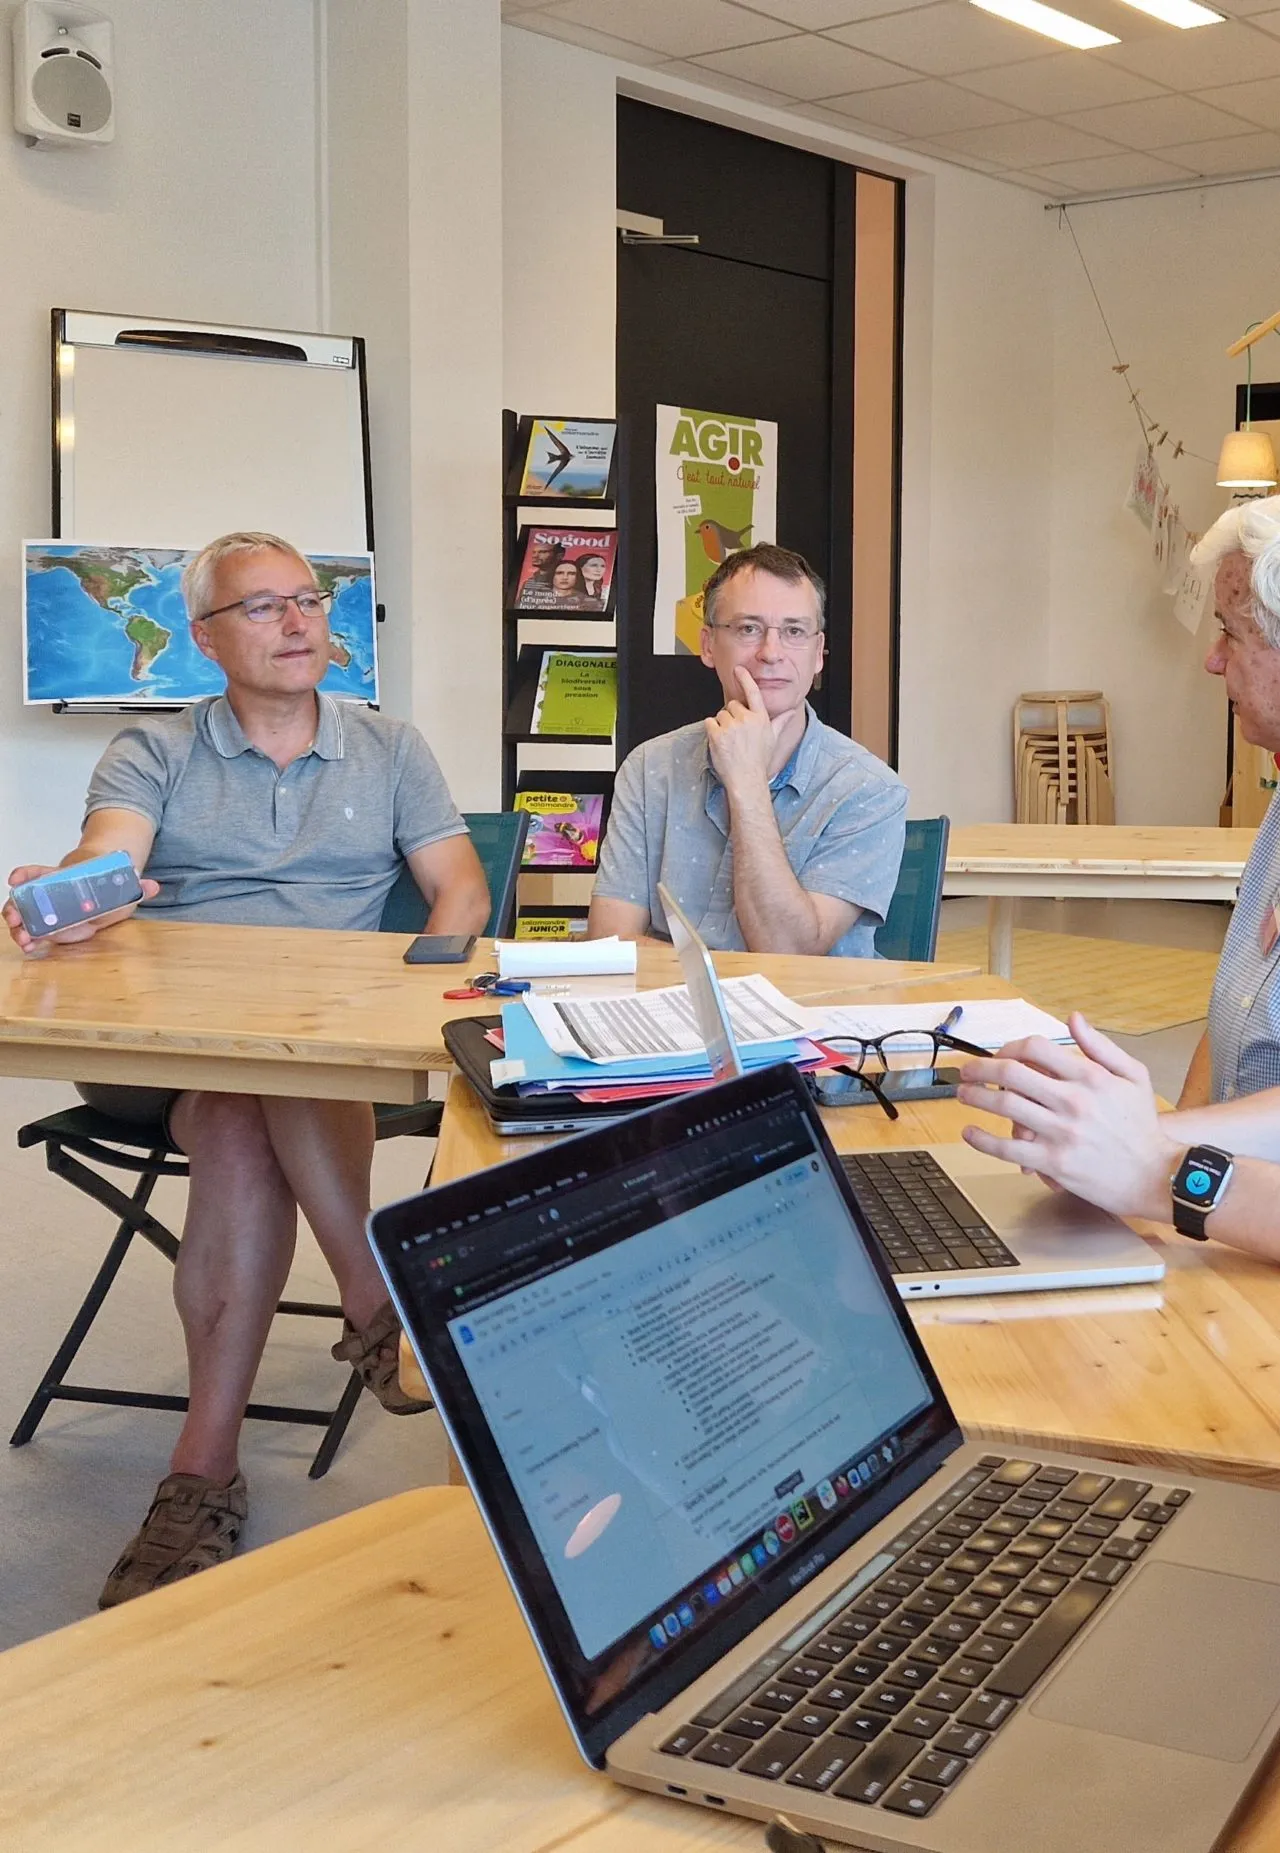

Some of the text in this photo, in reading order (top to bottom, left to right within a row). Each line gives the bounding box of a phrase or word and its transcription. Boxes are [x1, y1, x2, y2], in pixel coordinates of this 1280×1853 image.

[669, 418, 765, 471] AGIR
[526, 794, 559, 803] petite
[528, 925, 566, 935] JUNIOR
